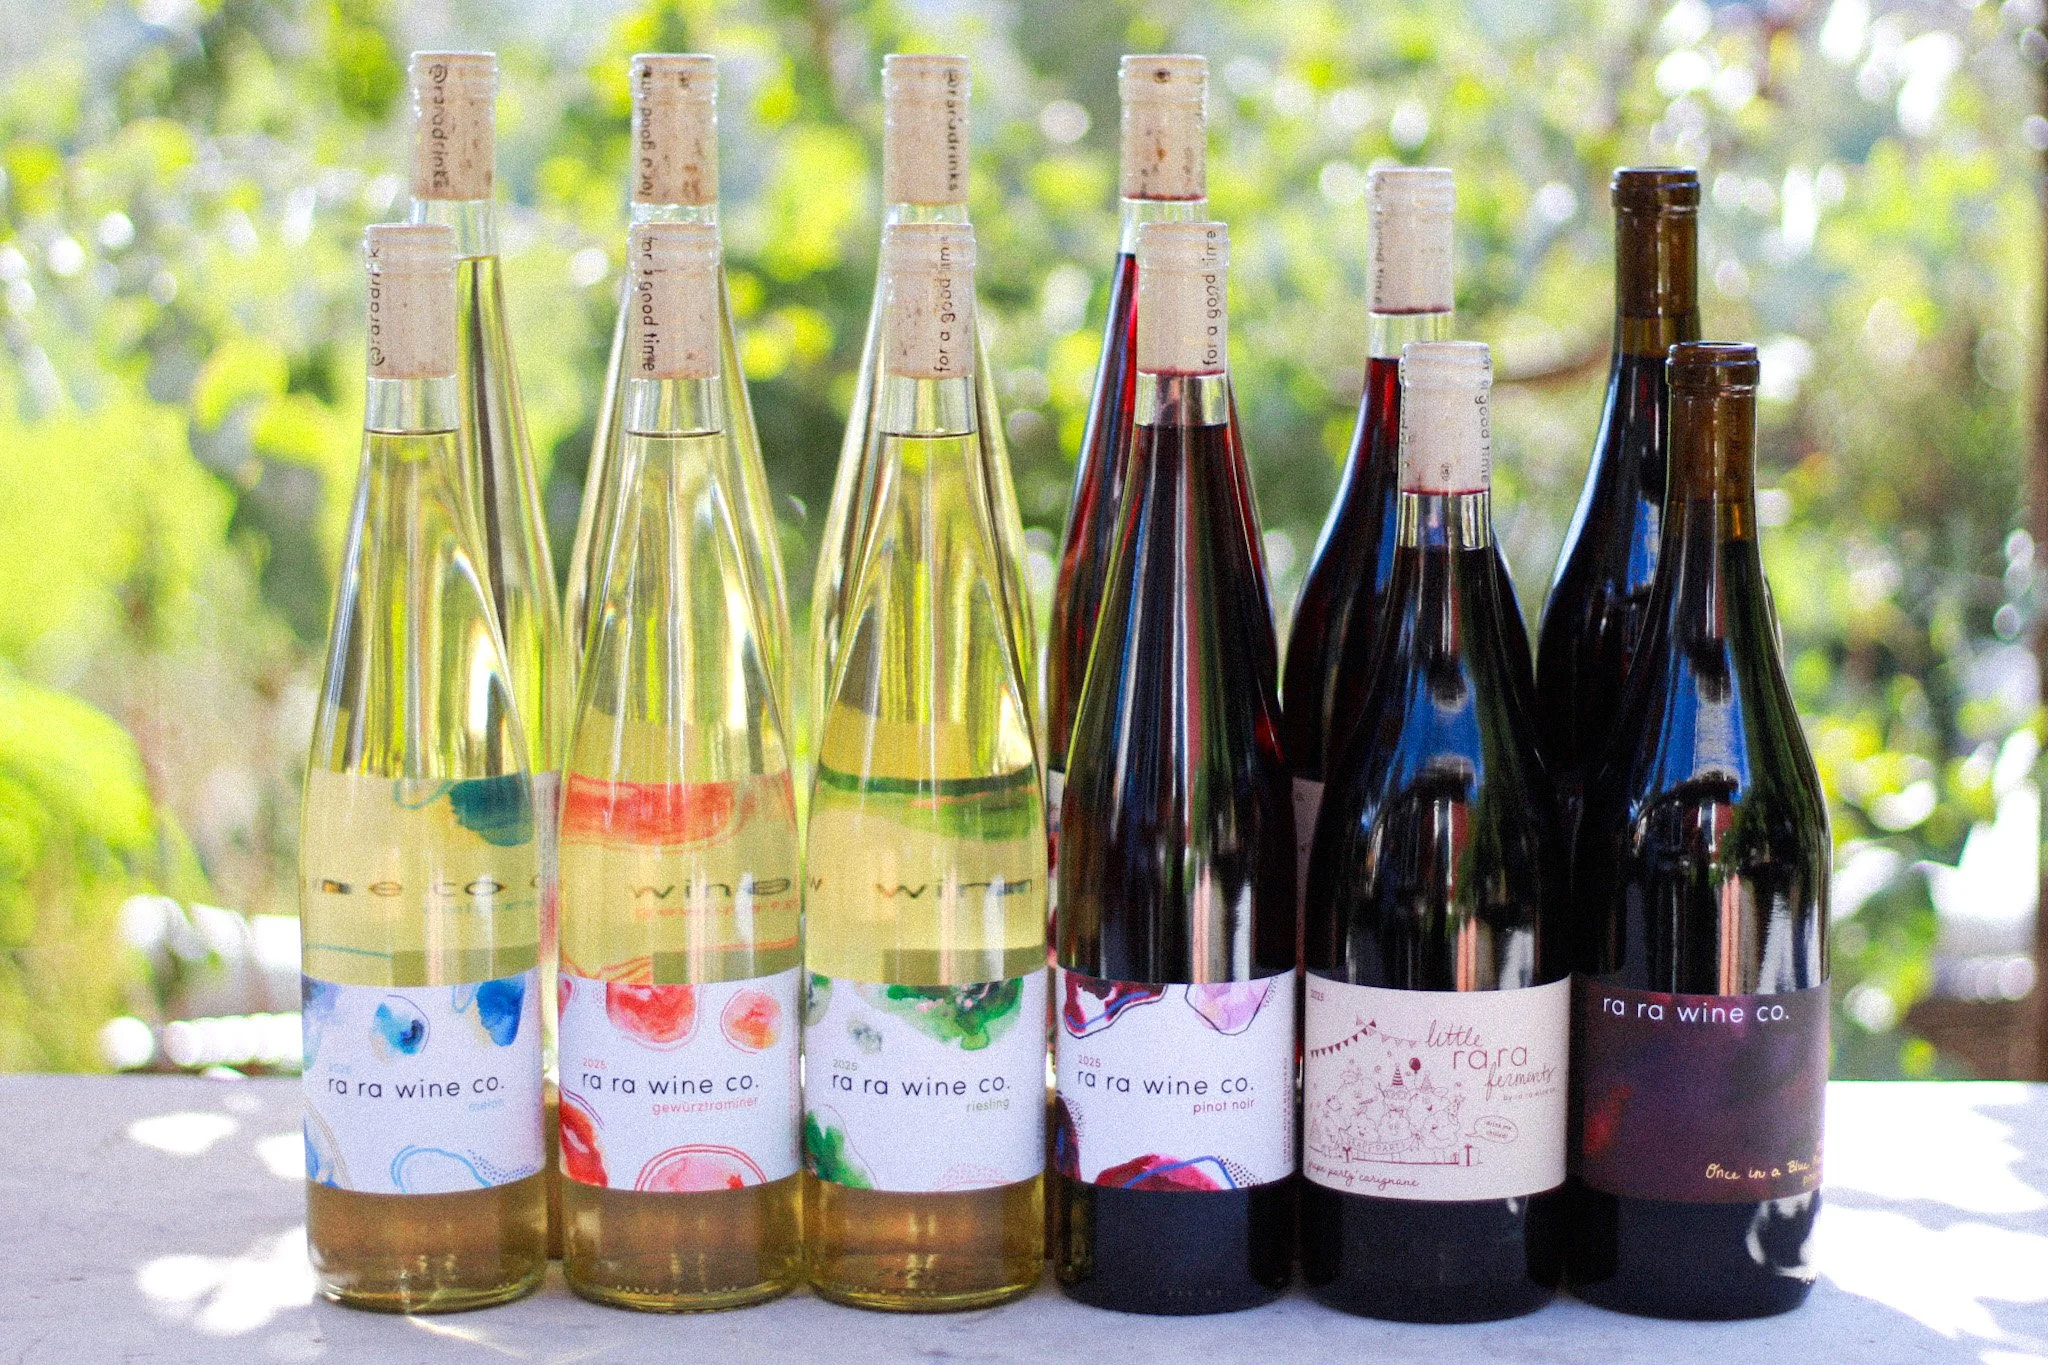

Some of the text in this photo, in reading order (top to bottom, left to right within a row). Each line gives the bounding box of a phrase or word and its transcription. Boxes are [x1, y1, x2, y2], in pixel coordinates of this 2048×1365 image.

[428, 63, 449, 188] @raradrinks
[639, 281, 660, 326] good
[938, 278, 956, 323] good
[1201, 274, 1221, 319] good
[940, 330, 951, 341] a
[1207, 325, 1218, 336] a
[642, 332, 661, 371] time
[933, 348, 951, 372] for
[1202, 342, 1218, 366] for
[1474, 395, 1490, 439] good
[1603, 997, 1789, 1023] ra ra wine co.
[1427, 1019, 1484, 1048] little
[582, 1057, 607, 1070] 2025
[832, 1058, 859, 1071] 2025
[1077, 1054, 1101, 1068] 2025
[328, 1076, 505, 1098] ra ra wine co.
[582, 1073, 759, 1095] ra ra wine co.
[832, 1073, 1011, 1096] ra ra wine co.
[1077, 1069, 1255, 1095] ra ra wine co.
[966, 1097, 1010, 1113] riesling
[1192, 1097, 1255, 1116] pinot noir
[1705, 1162, 1741, 1179] Once
[1771, 1167, 1782, 1178] a
[1786, 1160, 1810, 1174] Blue
